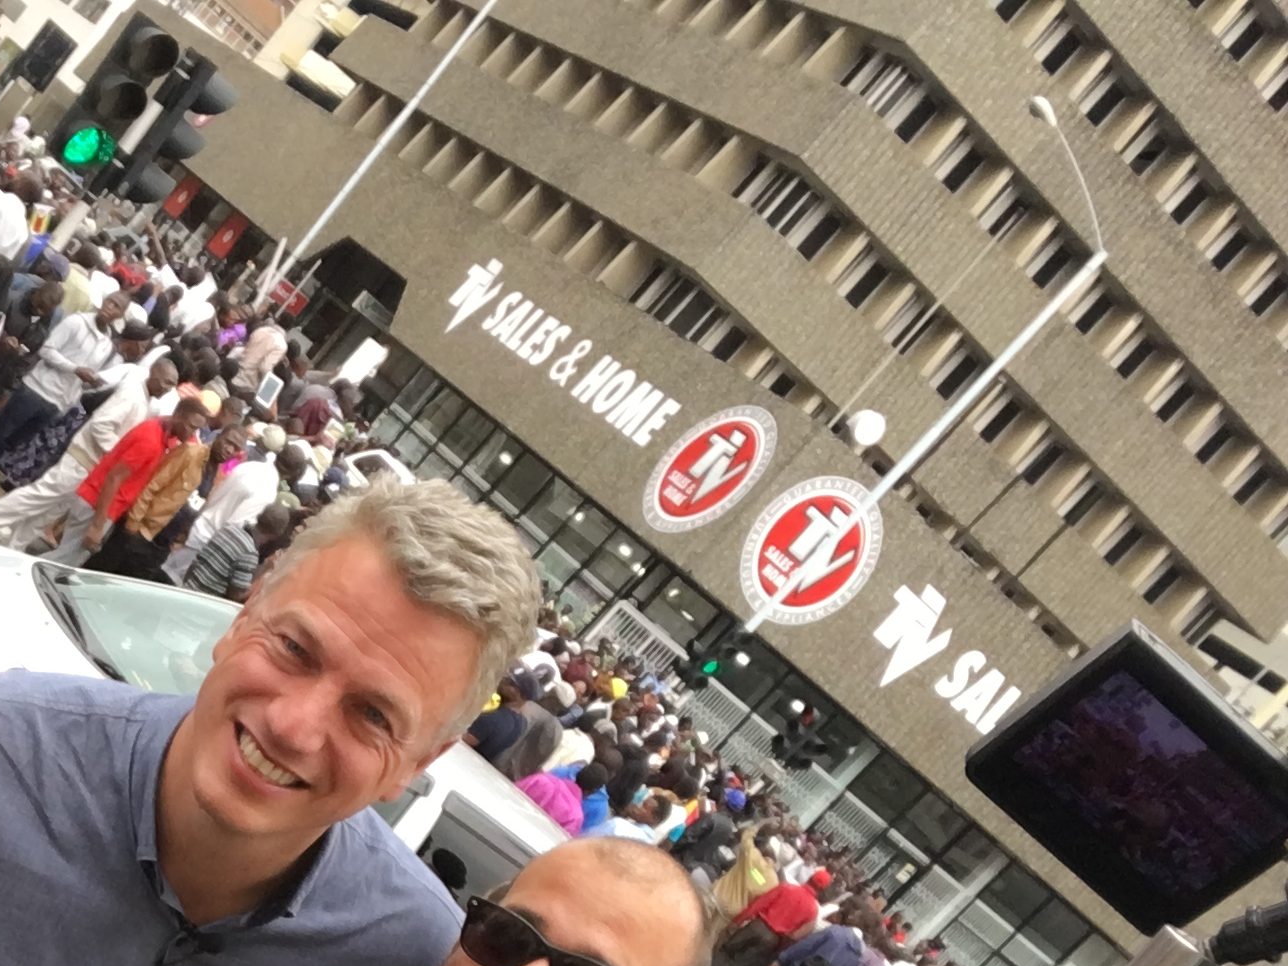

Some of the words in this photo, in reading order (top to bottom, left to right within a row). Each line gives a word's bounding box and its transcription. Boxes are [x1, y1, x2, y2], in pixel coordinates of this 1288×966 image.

[444, 258, 504, 334] TV
[482, 291, 572, 366] SALES
[550, 339, 593, 387] &
[571, 355, 682, 447] HOME
[689, 429, 748, 504] TV
[873, 583, 953, 687] TV
